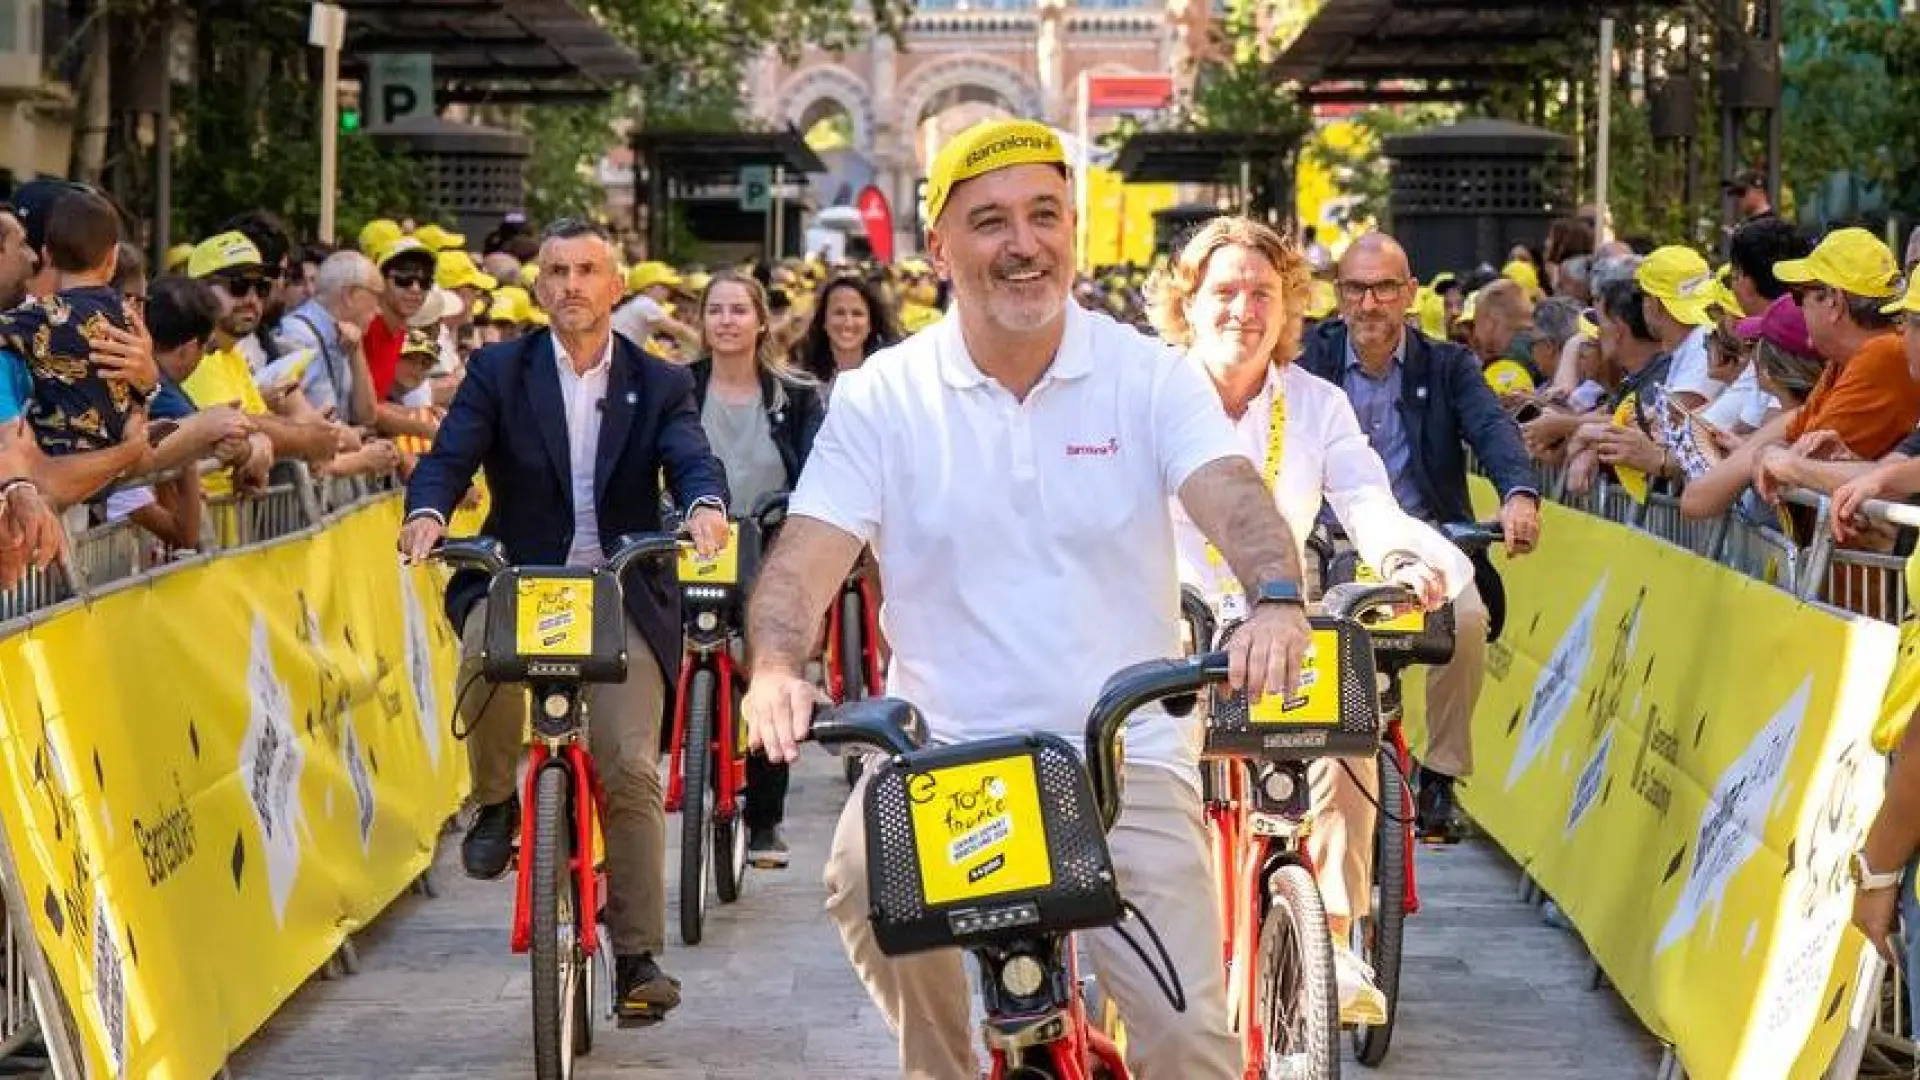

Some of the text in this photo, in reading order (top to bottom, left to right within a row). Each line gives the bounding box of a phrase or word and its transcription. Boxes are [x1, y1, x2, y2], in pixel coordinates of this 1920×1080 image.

[383, 85, 418, 125] P
[966, 134, 1042, 168] Barcelona
[746, 181, 765, 206] P
